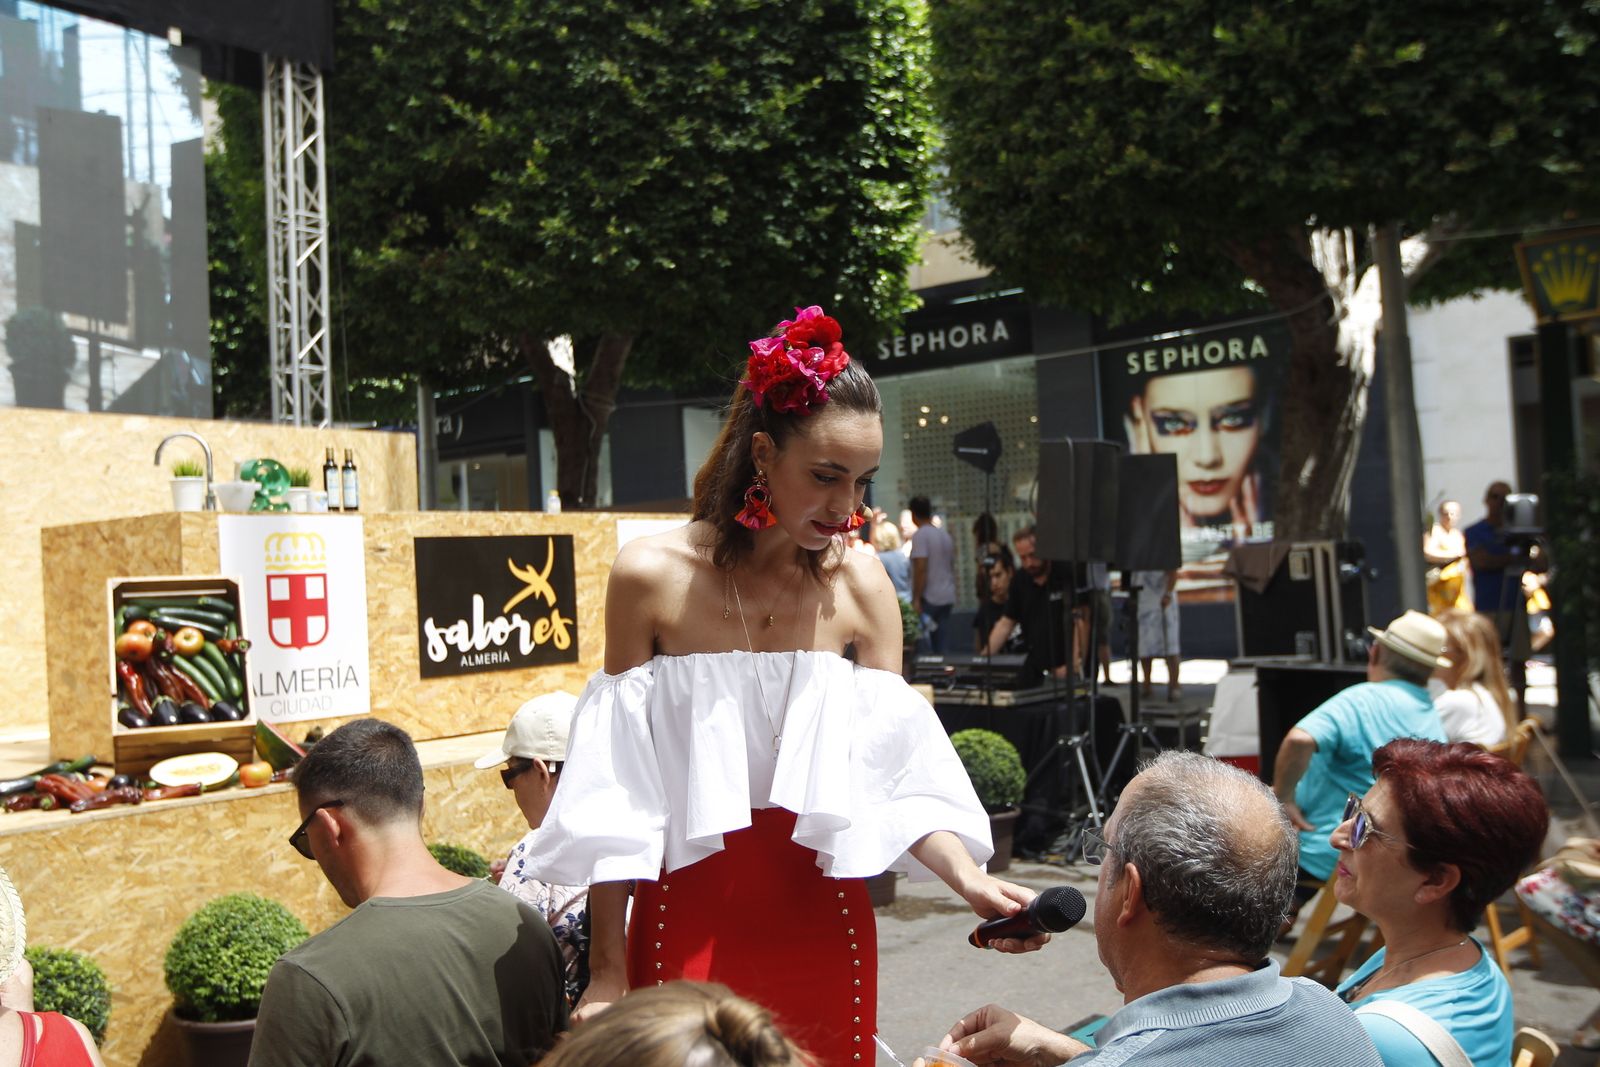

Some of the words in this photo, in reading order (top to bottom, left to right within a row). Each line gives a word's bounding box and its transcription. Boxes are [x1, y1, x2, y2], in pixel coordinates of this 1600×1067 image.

[877, 319, 1009, 361] SEPHORA
[1126, 334, 1269, 375] SEPHORA
[424, 593, 574, 662] sabores
[252, 659, 360, 697] LMERÍA
[460, 650, 511, 668] ALMERÍA
[270, 695, 333, 716] CIUDAD
